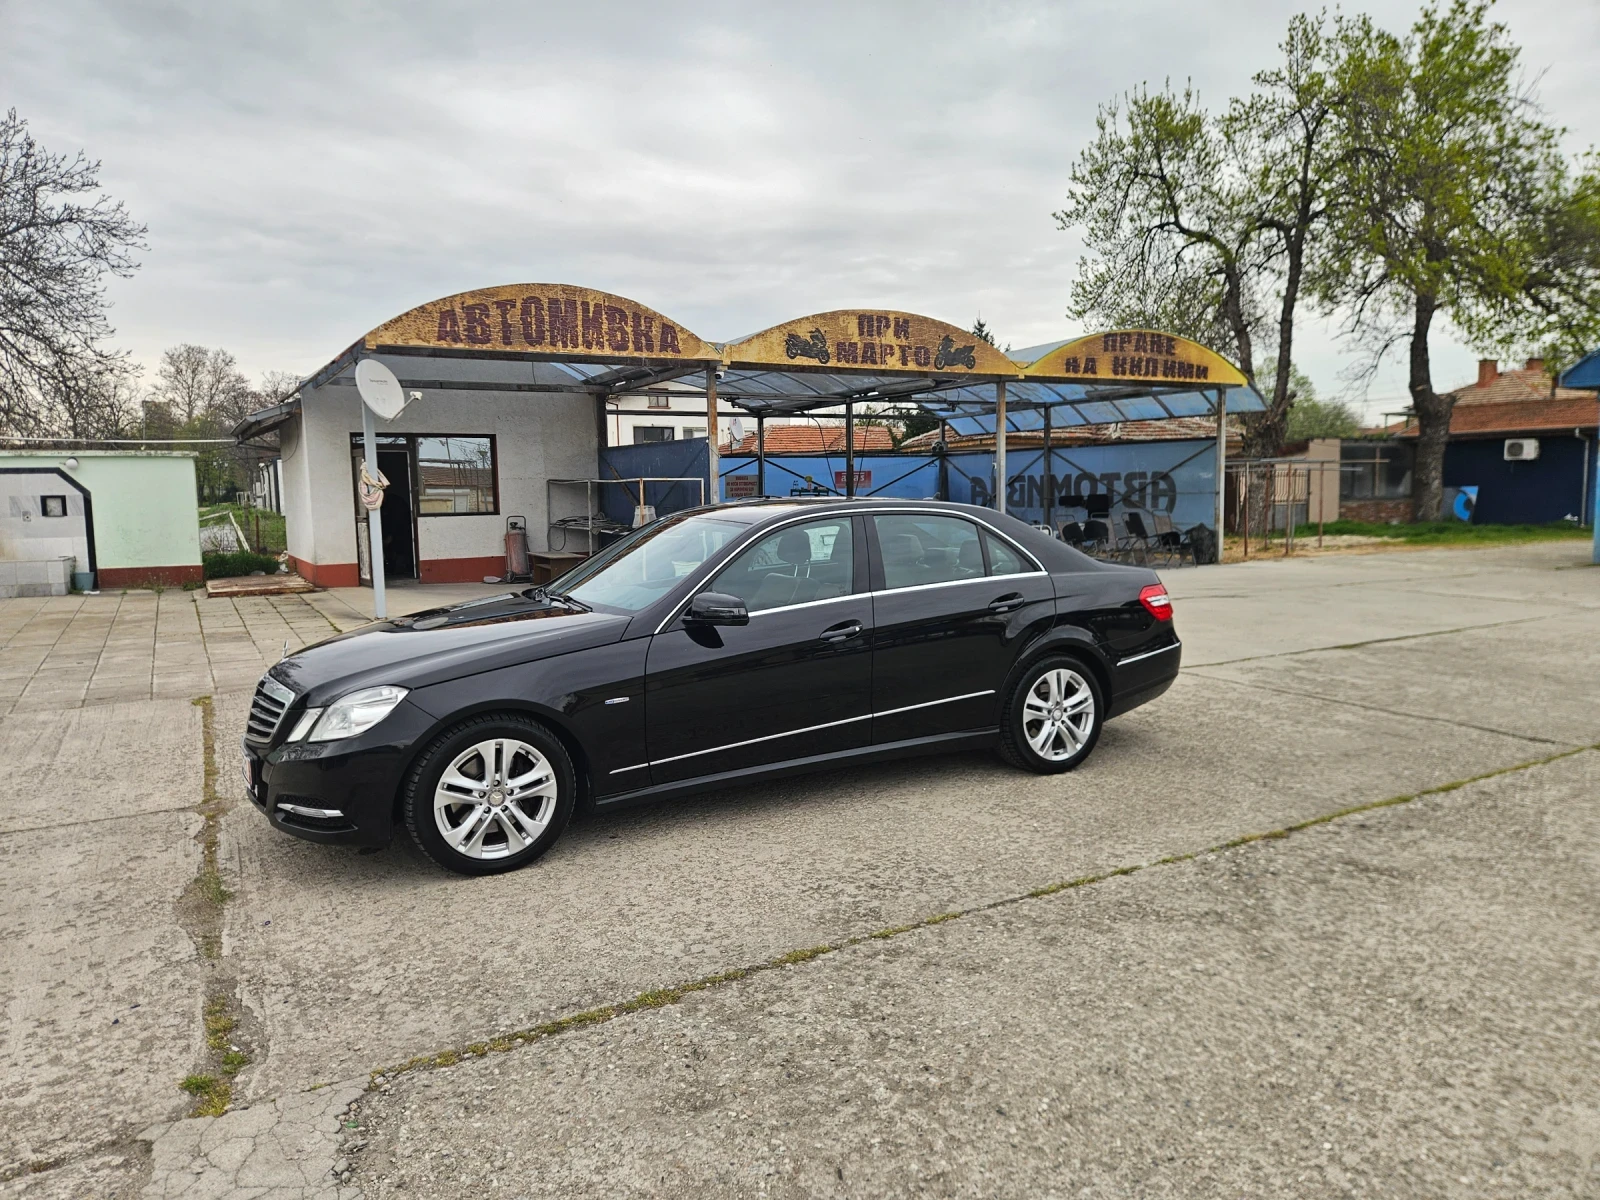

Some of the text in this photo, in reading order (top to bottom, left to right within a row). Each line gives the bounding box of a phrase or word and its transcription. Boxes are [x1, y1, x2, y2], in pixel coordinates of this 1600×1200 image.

[437, 296, 681, 354] АВТОМИВКА
[858, 314, 909, 340] ПРИ
[837, 341, 930, 367] МАРТО
[1104, 332, 1176, 356] ПРАНЕ
[1065, 356, 1209, 379] НА КИЛИМИ
